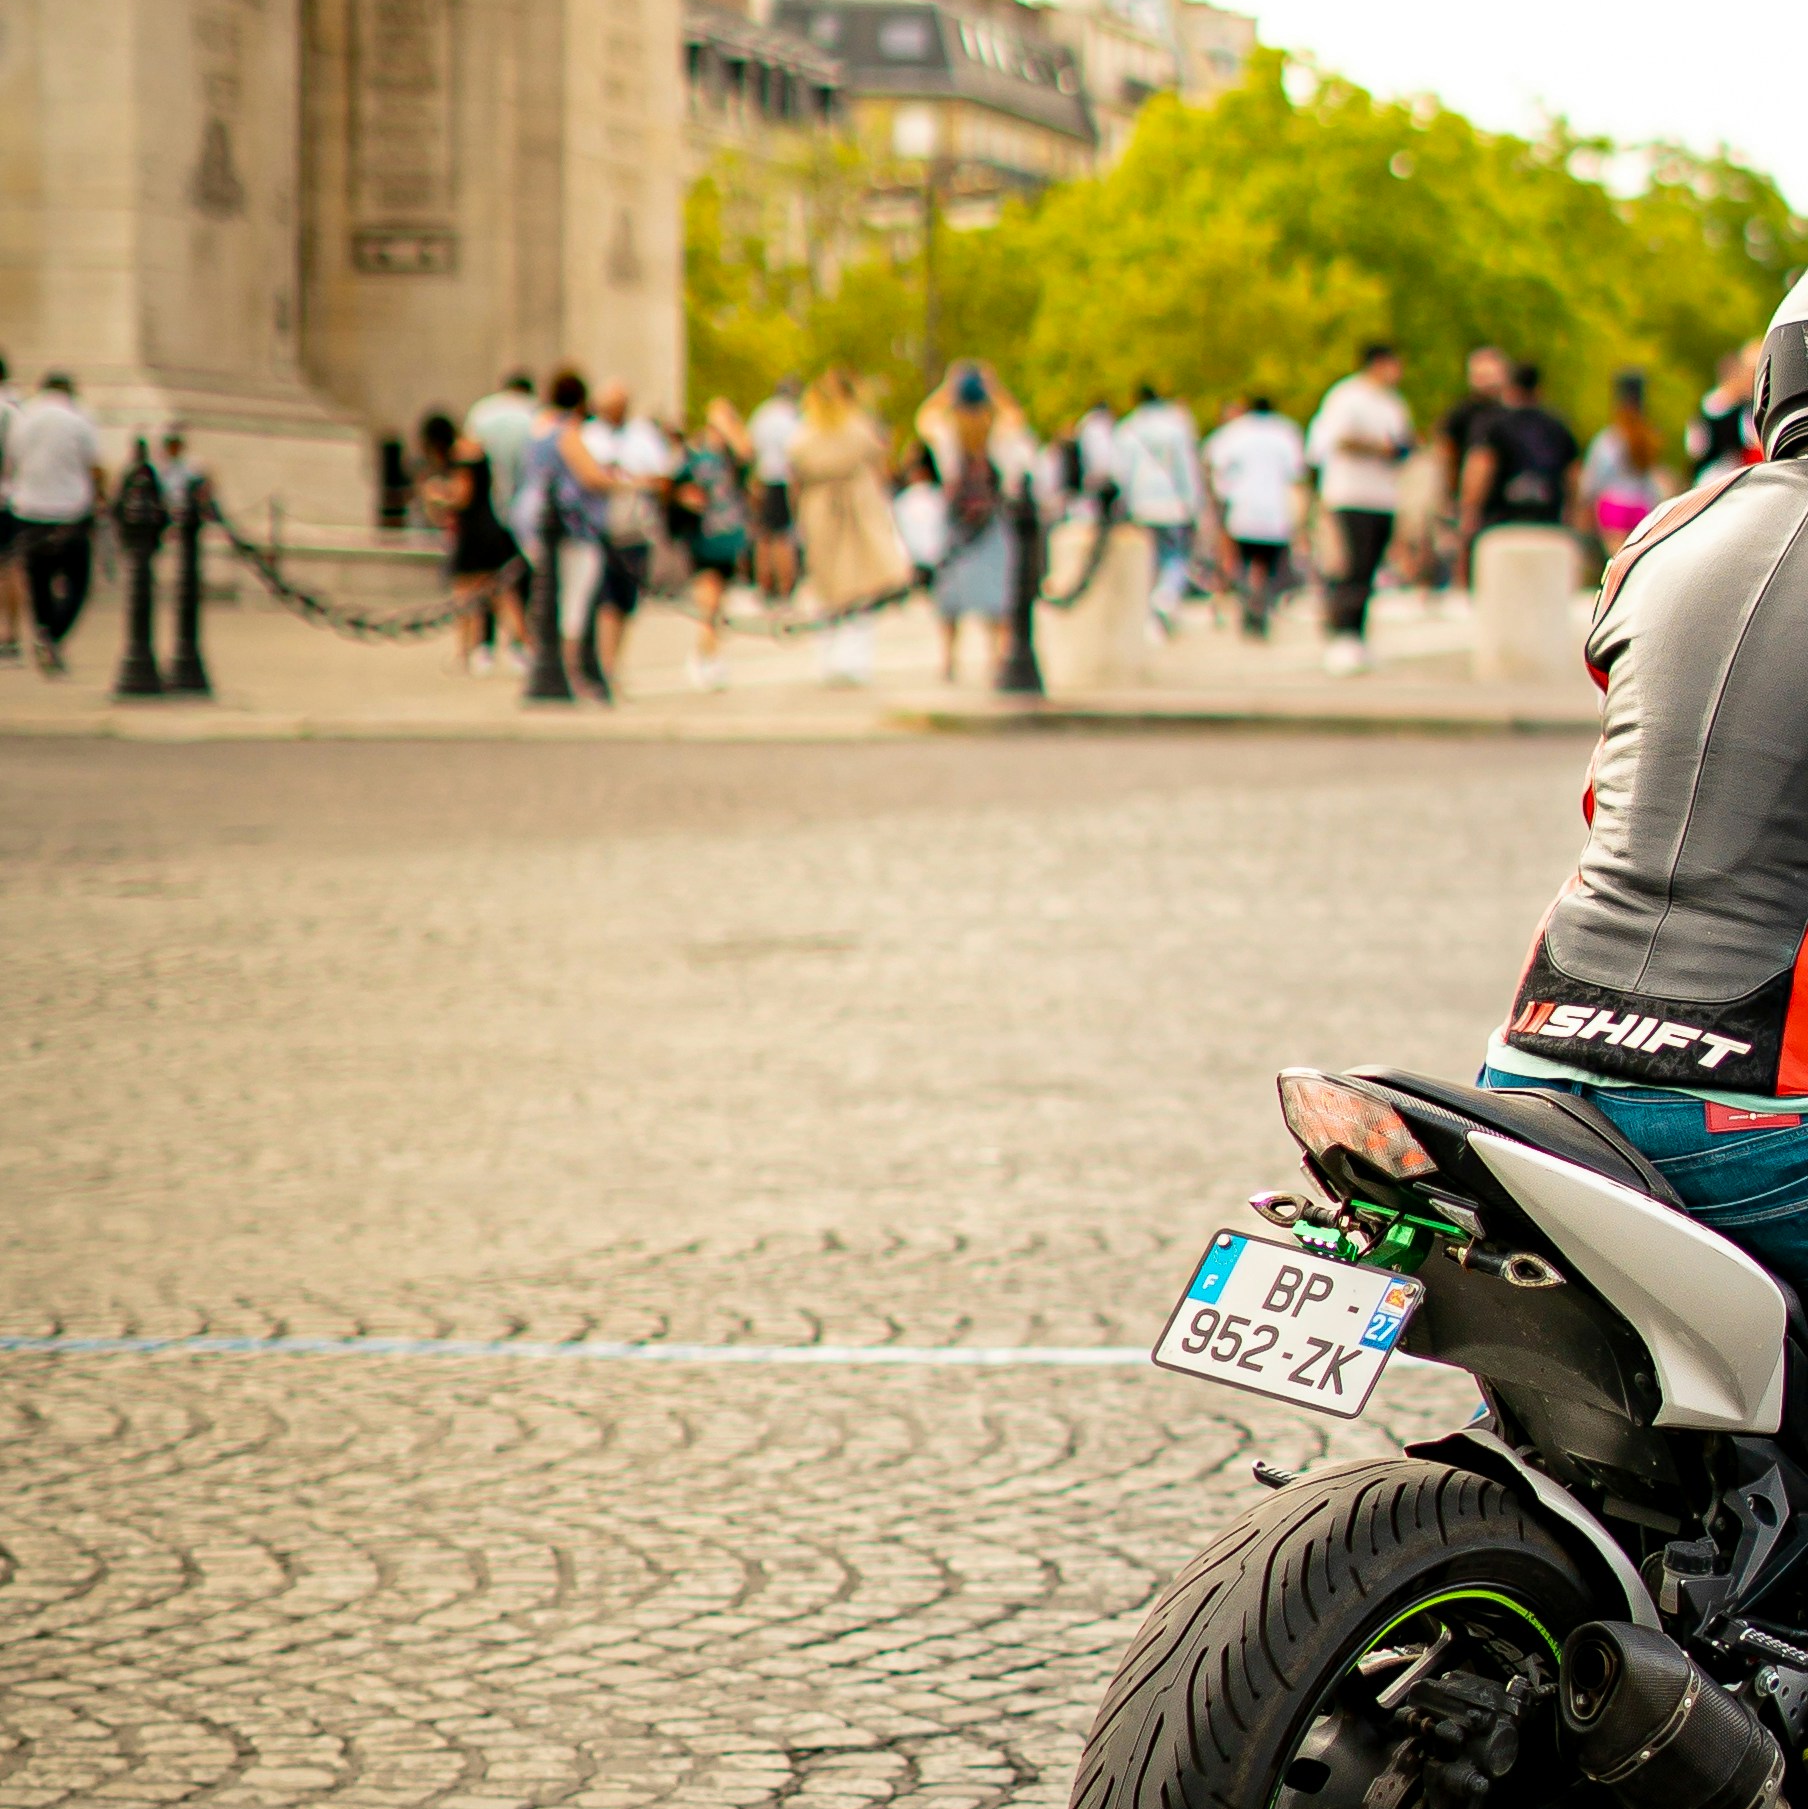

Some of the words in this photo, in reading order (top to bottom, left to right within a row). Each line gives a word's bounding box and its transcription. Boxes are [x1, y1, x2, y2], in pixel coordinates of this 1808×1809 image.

[1539, 1004, 1752, 1068] SHIFT
[1202, 1273, 1219, 1290] F
[1262, 1264, 1334, 1318] BP
[1182, 1308, 1362, 1395] 952-ZK
[1365, 1314, 1400, 1342] 27
[1526, 1610, 1562, 1659] Kawasaki
